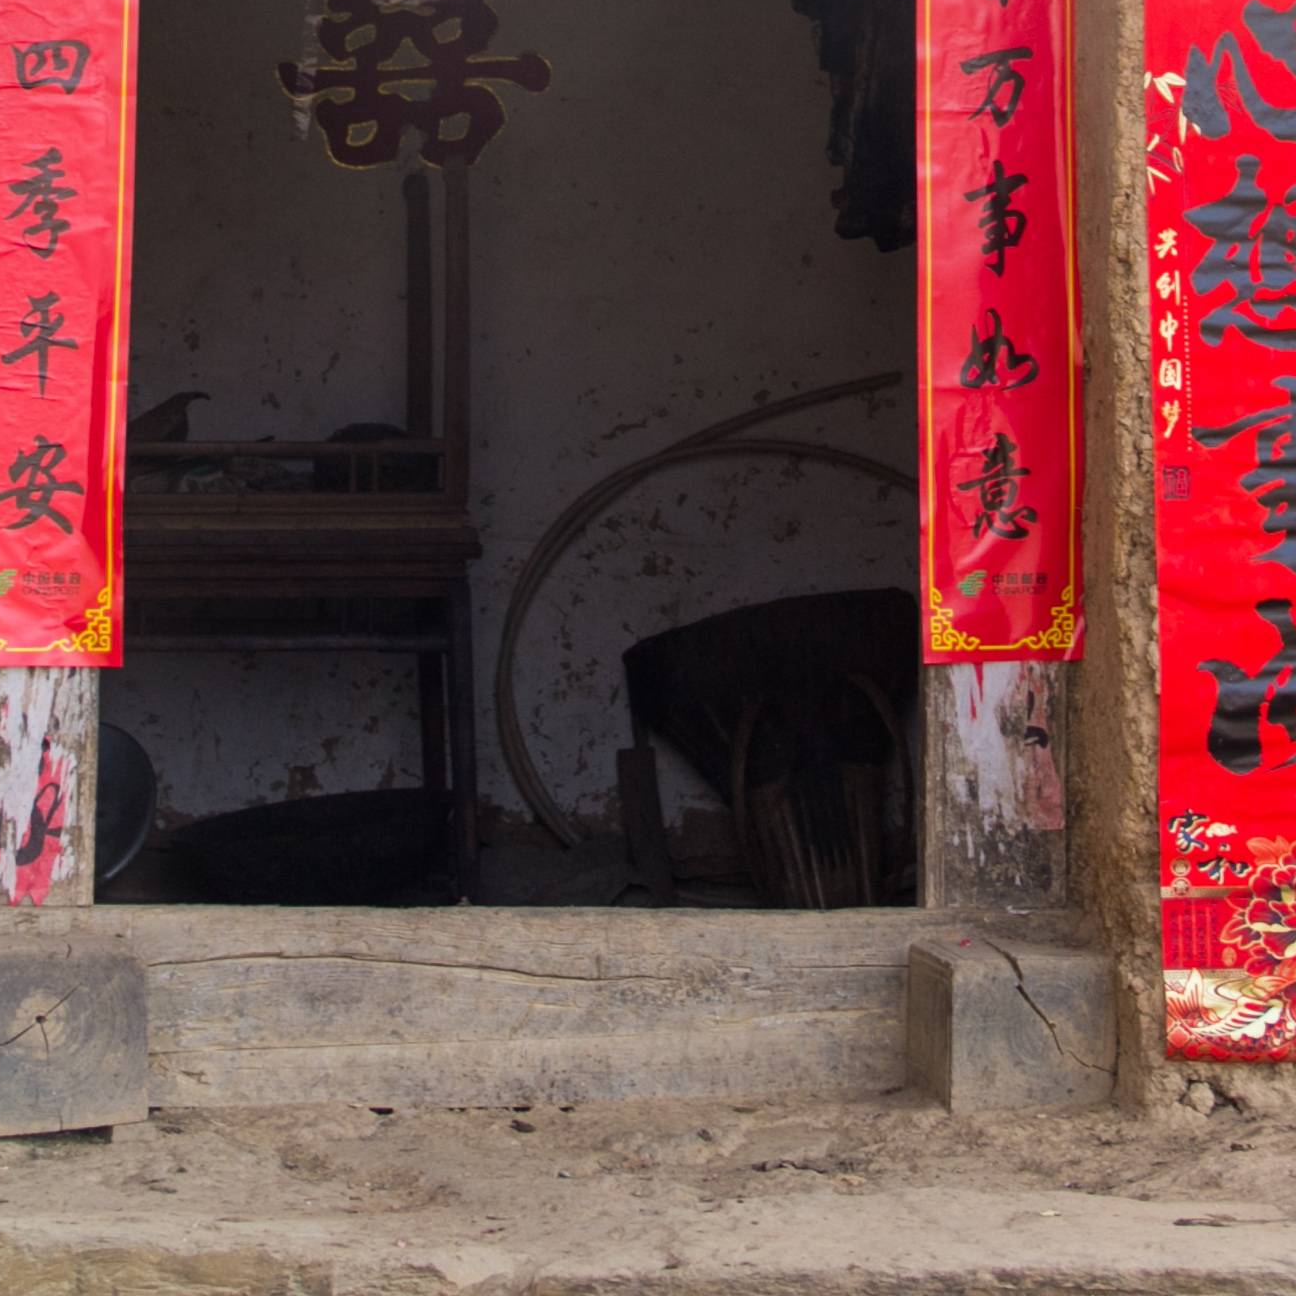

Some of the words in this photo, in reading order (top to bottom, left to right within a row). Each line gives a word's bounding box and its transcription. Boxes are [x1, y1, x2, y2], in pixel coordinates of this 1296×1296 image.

[1153, 227, 1183, 439] 共创中国梦
